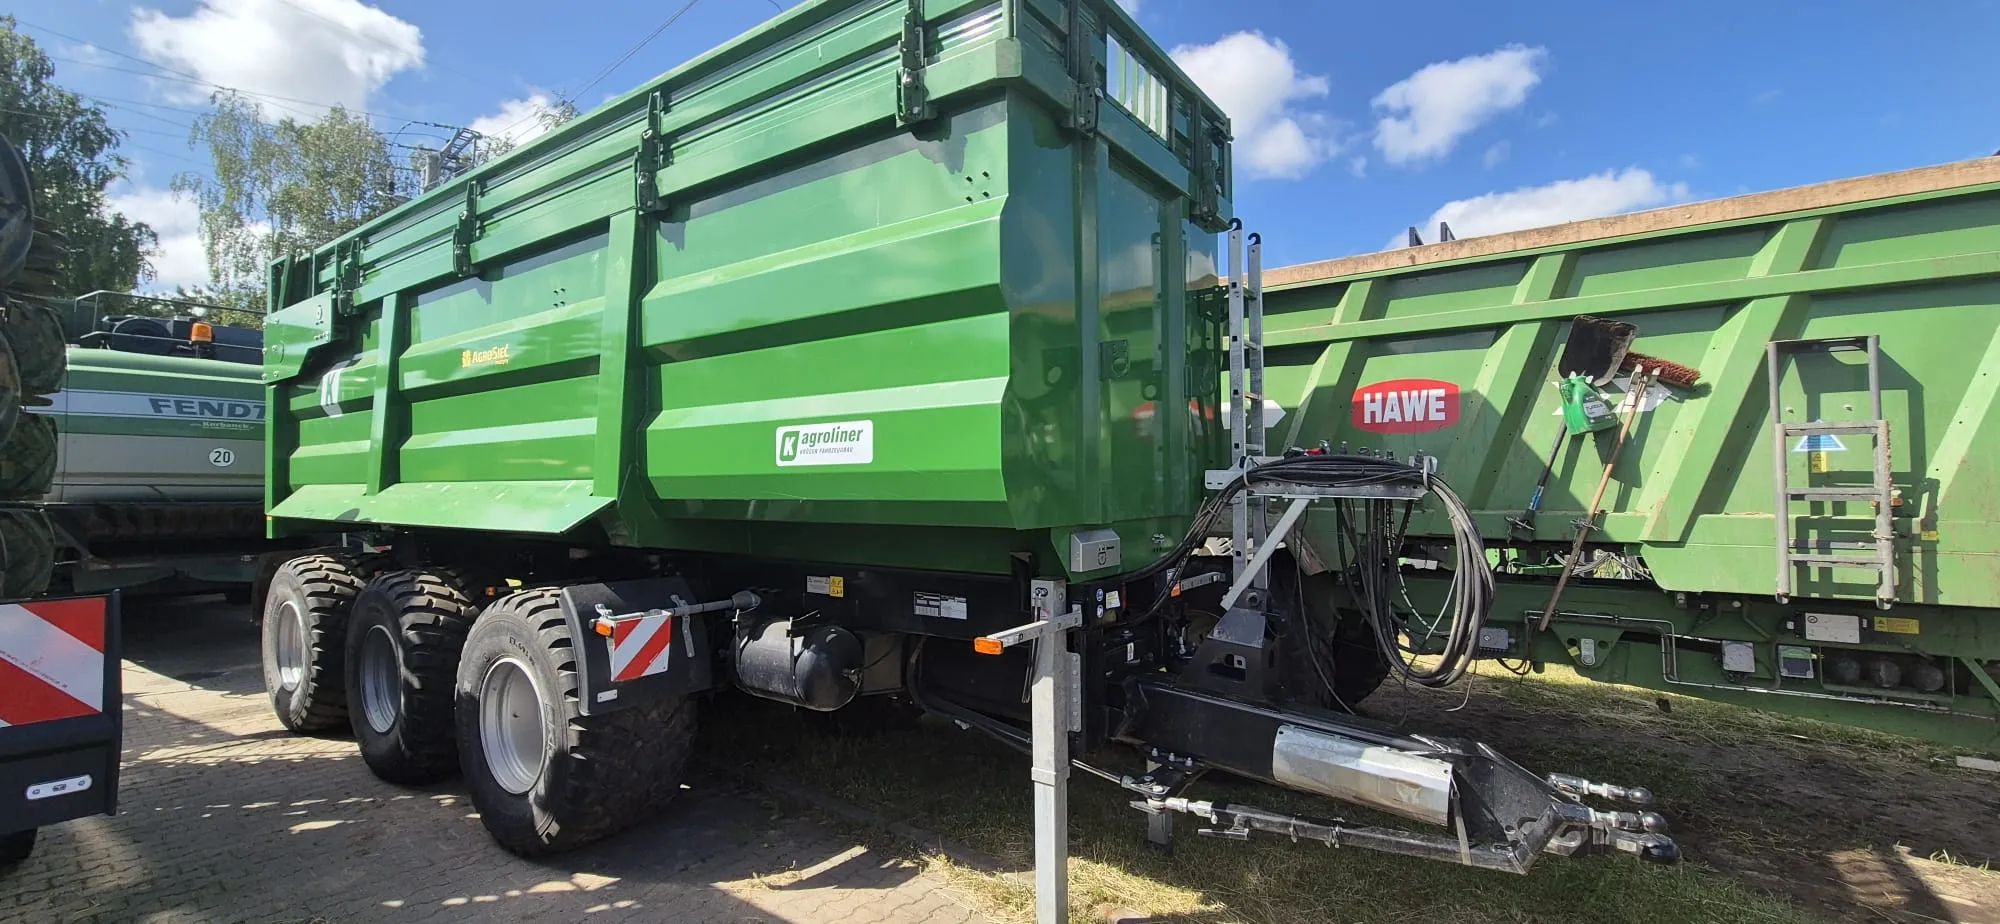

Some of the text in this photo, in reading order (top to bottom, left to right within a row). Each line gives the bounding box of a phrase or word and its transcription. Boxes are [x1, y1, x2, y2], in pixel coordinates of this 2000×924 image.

[1363, 388, 1445, 424] HAWE
[783, 436, 796, 456] K
[801, 426, 863, 447] agroliner
[213, 450, 231, 463] 20
